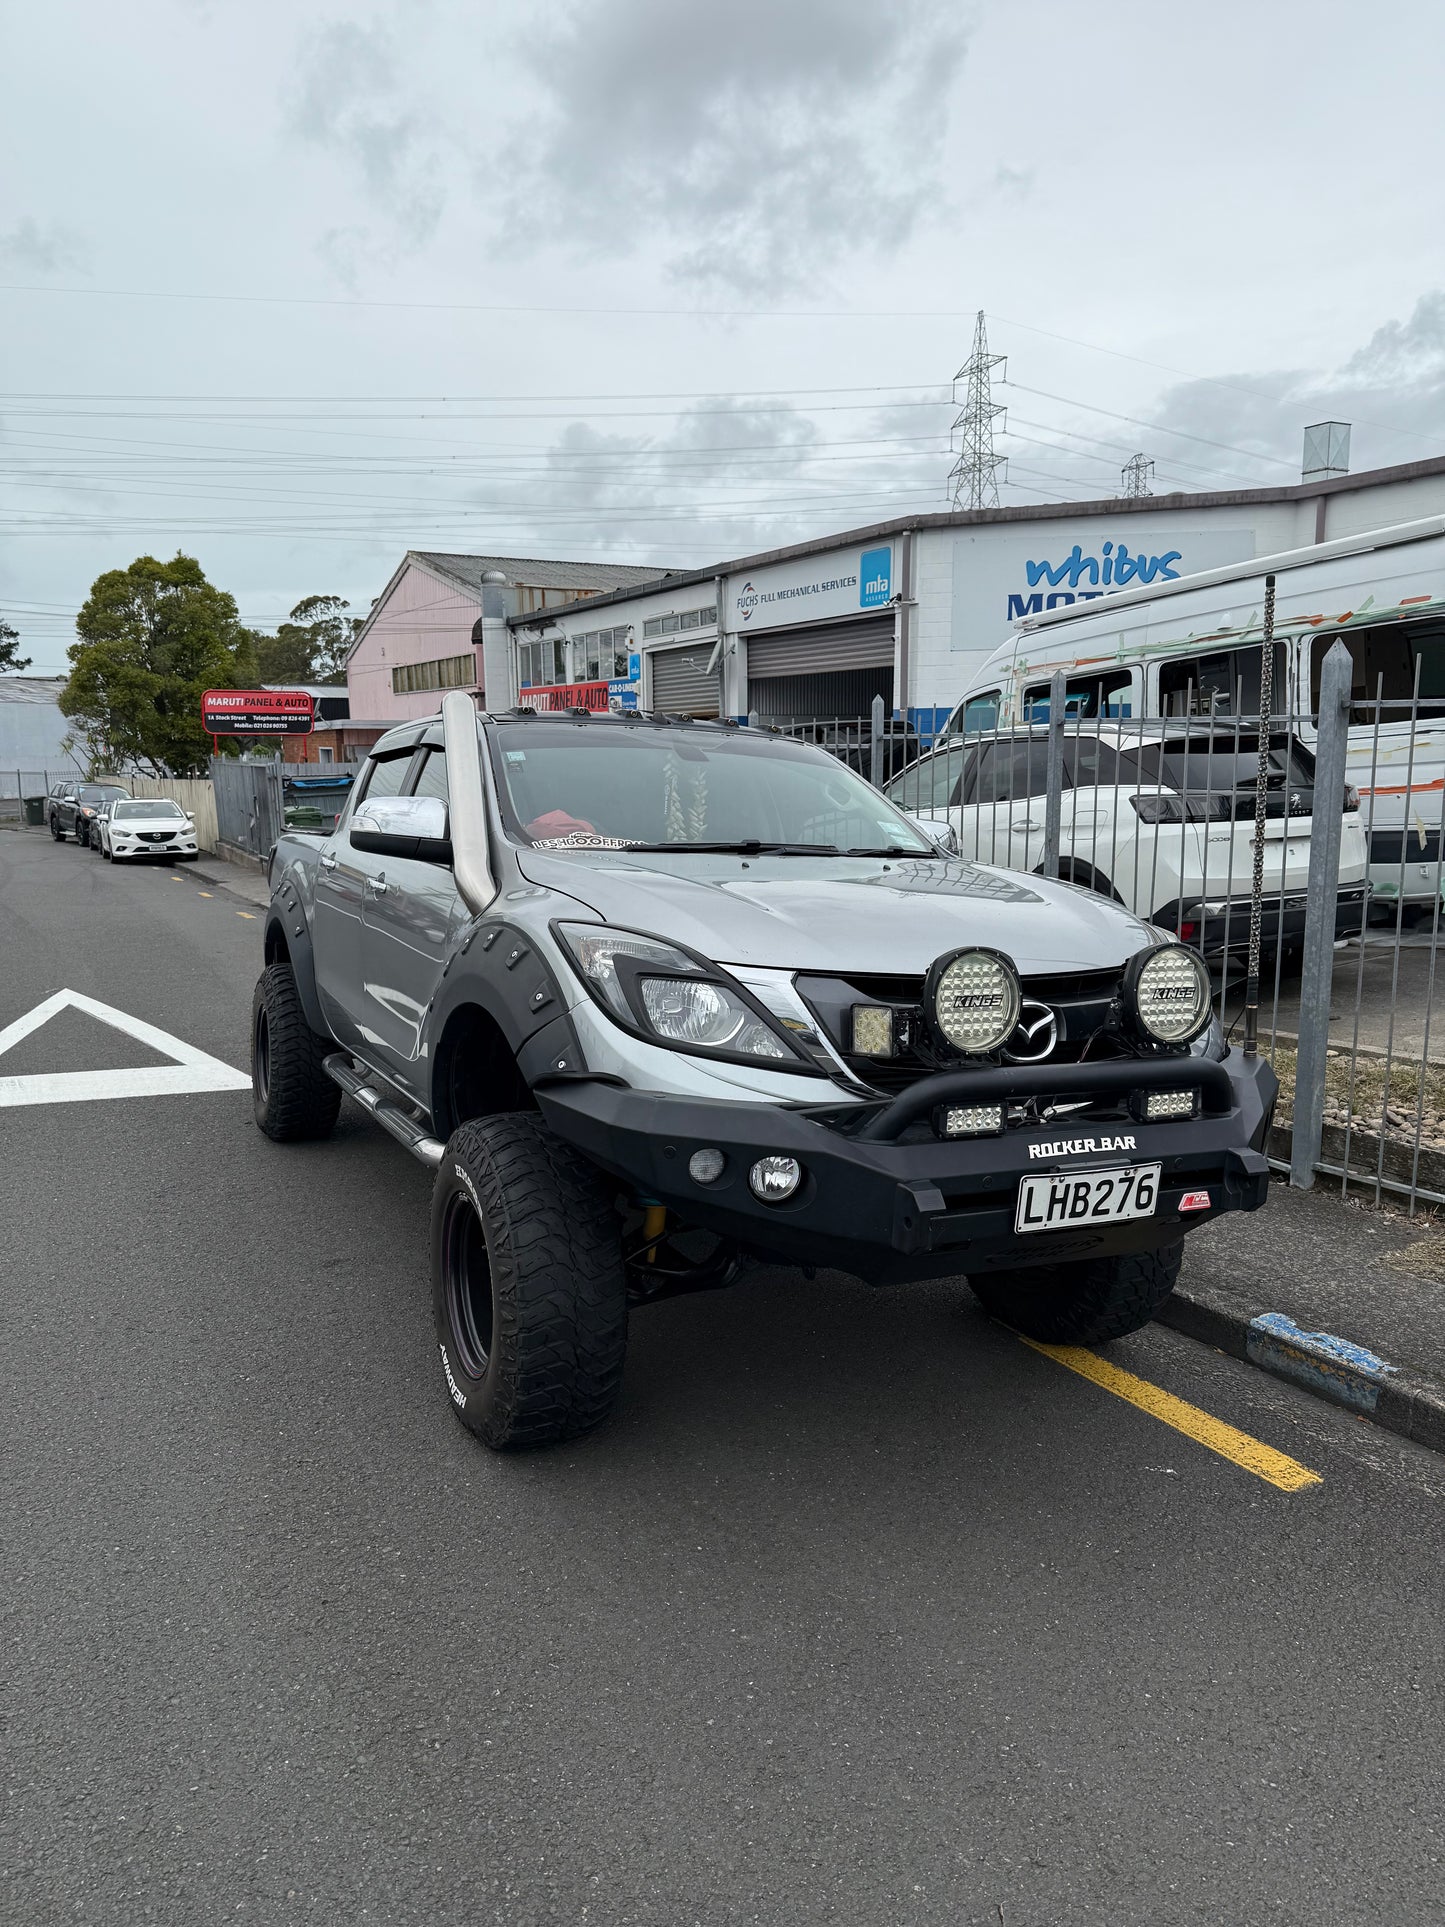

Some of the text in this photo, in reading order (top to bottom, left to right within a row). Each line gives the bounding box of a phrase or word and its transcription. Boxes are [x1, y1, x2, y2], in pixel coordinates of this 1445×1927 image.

[761, 576, 857, 604] FULL MECHANICAL SERVICES
[865, 574, 889, 595] mta
[737, 594, 758, 609] FUCHS
[207, 698, 309, 708] MARUTI PANEL & AUTO
[521, 694, 549, 711] MARUTI
[549, 689, 574, 711] PANEL
[576, 690, 584, 707] &
[584, 688, 608, 710] AUTO
[953, 994, 1004, 1008] KINGS
[1153, 987, 1197, 999] KINGS
[1028, 1136, 1137, 1159] ROCKER BAR
[1023, 1173, 1154, 1224] LHB276
[440, 1343, 467, 1408] HEADWAY
